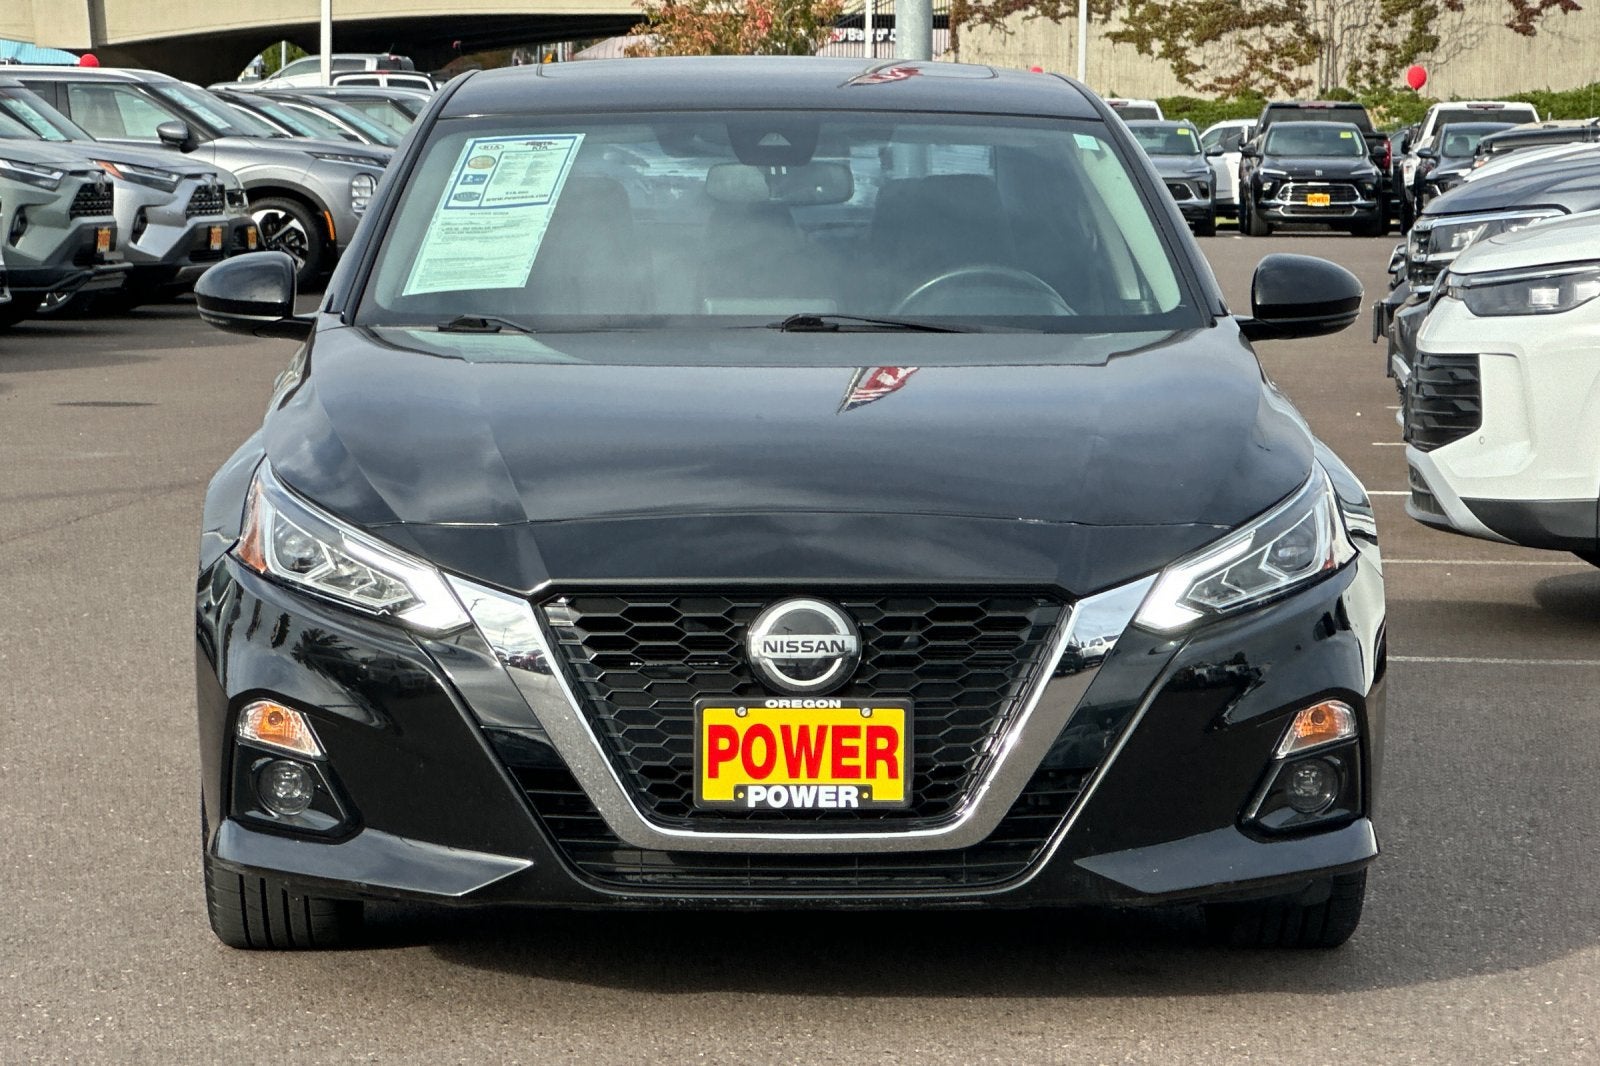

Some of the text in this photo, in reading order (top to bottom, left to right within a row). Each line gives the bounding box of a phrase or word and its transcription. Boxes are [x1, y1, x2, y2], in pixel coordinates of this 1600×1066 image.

[763, 640, 845, 653] NISSAN
[764, 699, 842, 709] OREGON
[707, 723, 899, 780] POWER
[747, 785, 859, 808] POWER
